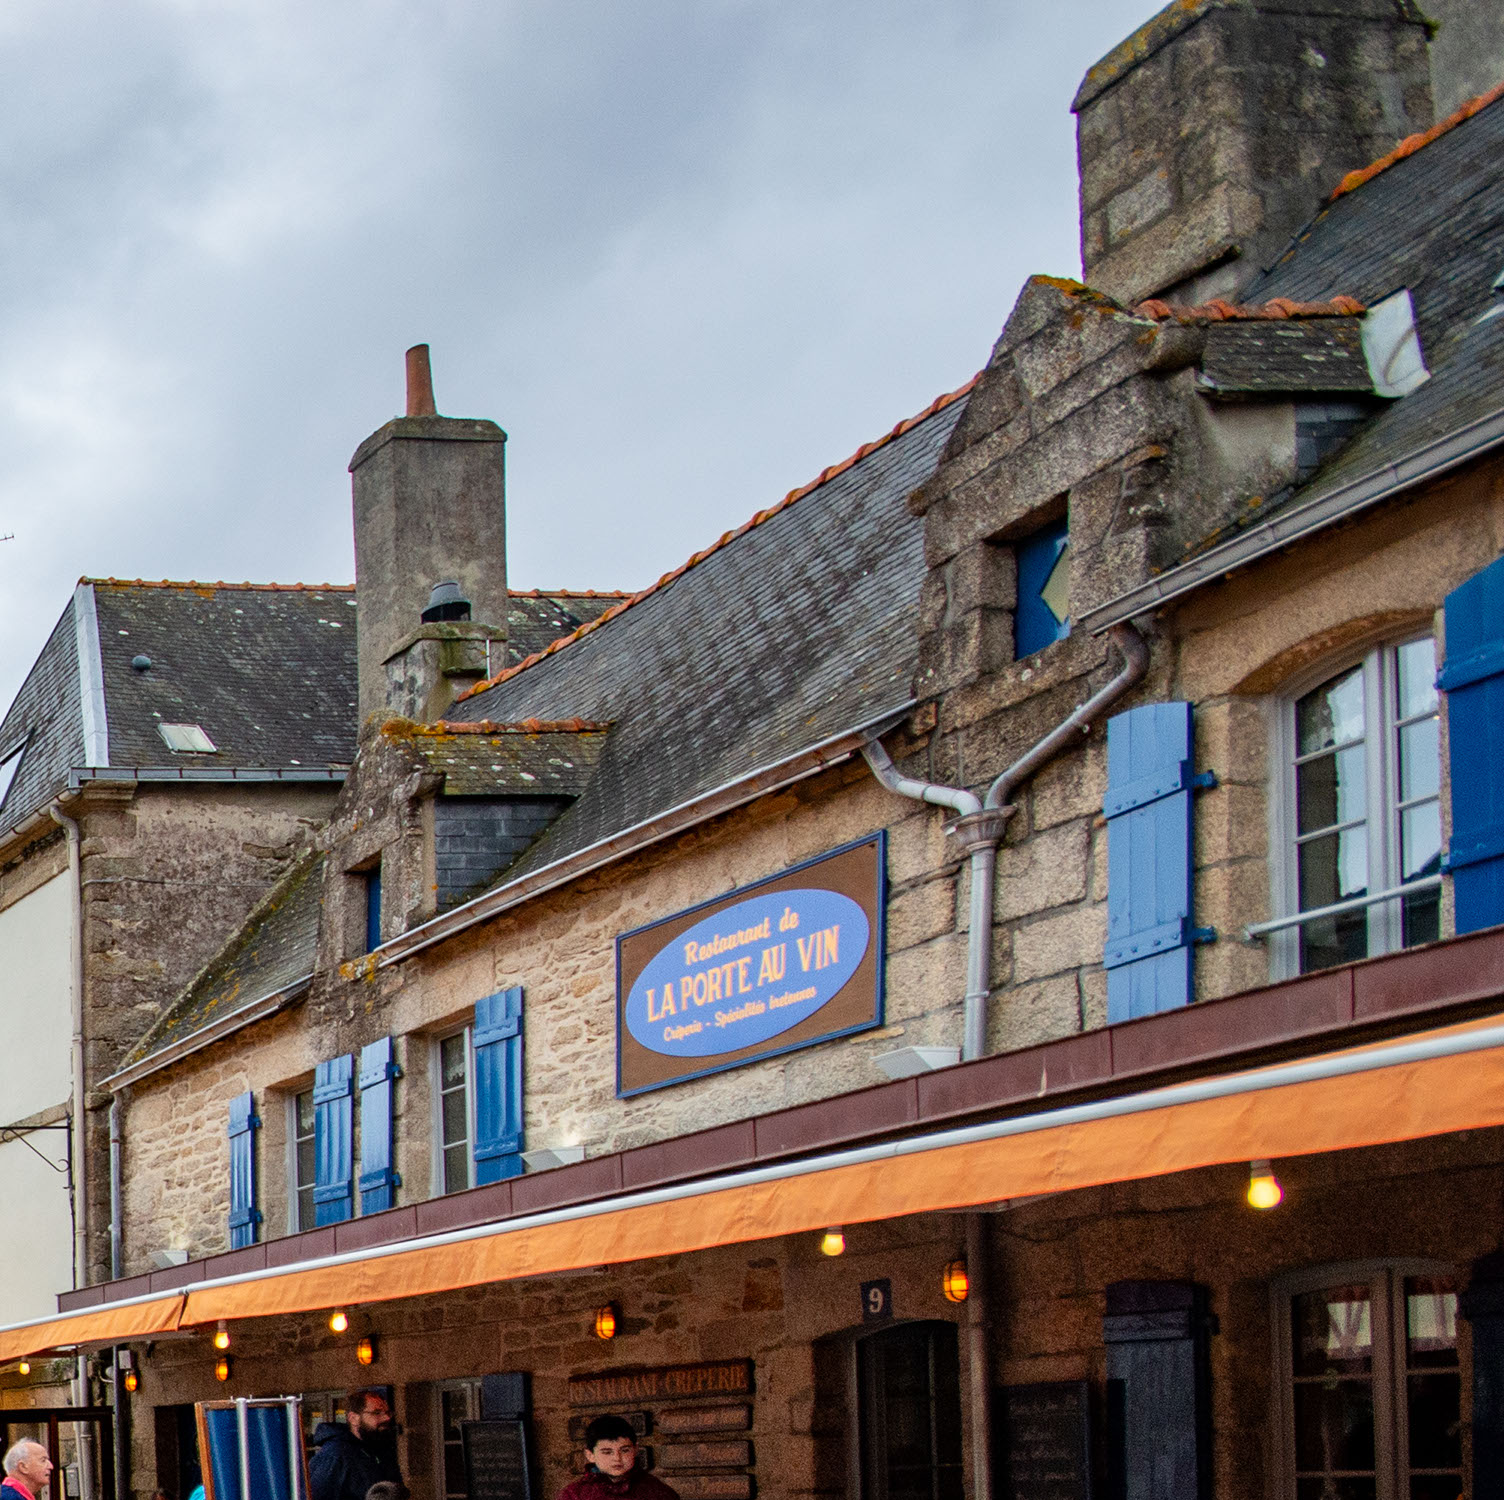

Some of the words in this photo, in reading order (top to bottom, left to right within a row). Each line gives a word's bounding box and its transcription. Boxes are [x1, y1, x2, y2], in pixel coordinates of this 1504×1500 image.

[684, 917, 771, 966] Restaurant
[779, 907, 799, 932] de
[645, 984, 677, 1023] LA
[680, 956, 753, 1011] PORTE
[757, 943, 786, 987] AU
[796, 925, 840, 972] VIN
[663, 1019, 703, 1042] Crêperie
[714, 1000, 766, 1029] Spécialités
[869, 1287, 883, 1313] 9
